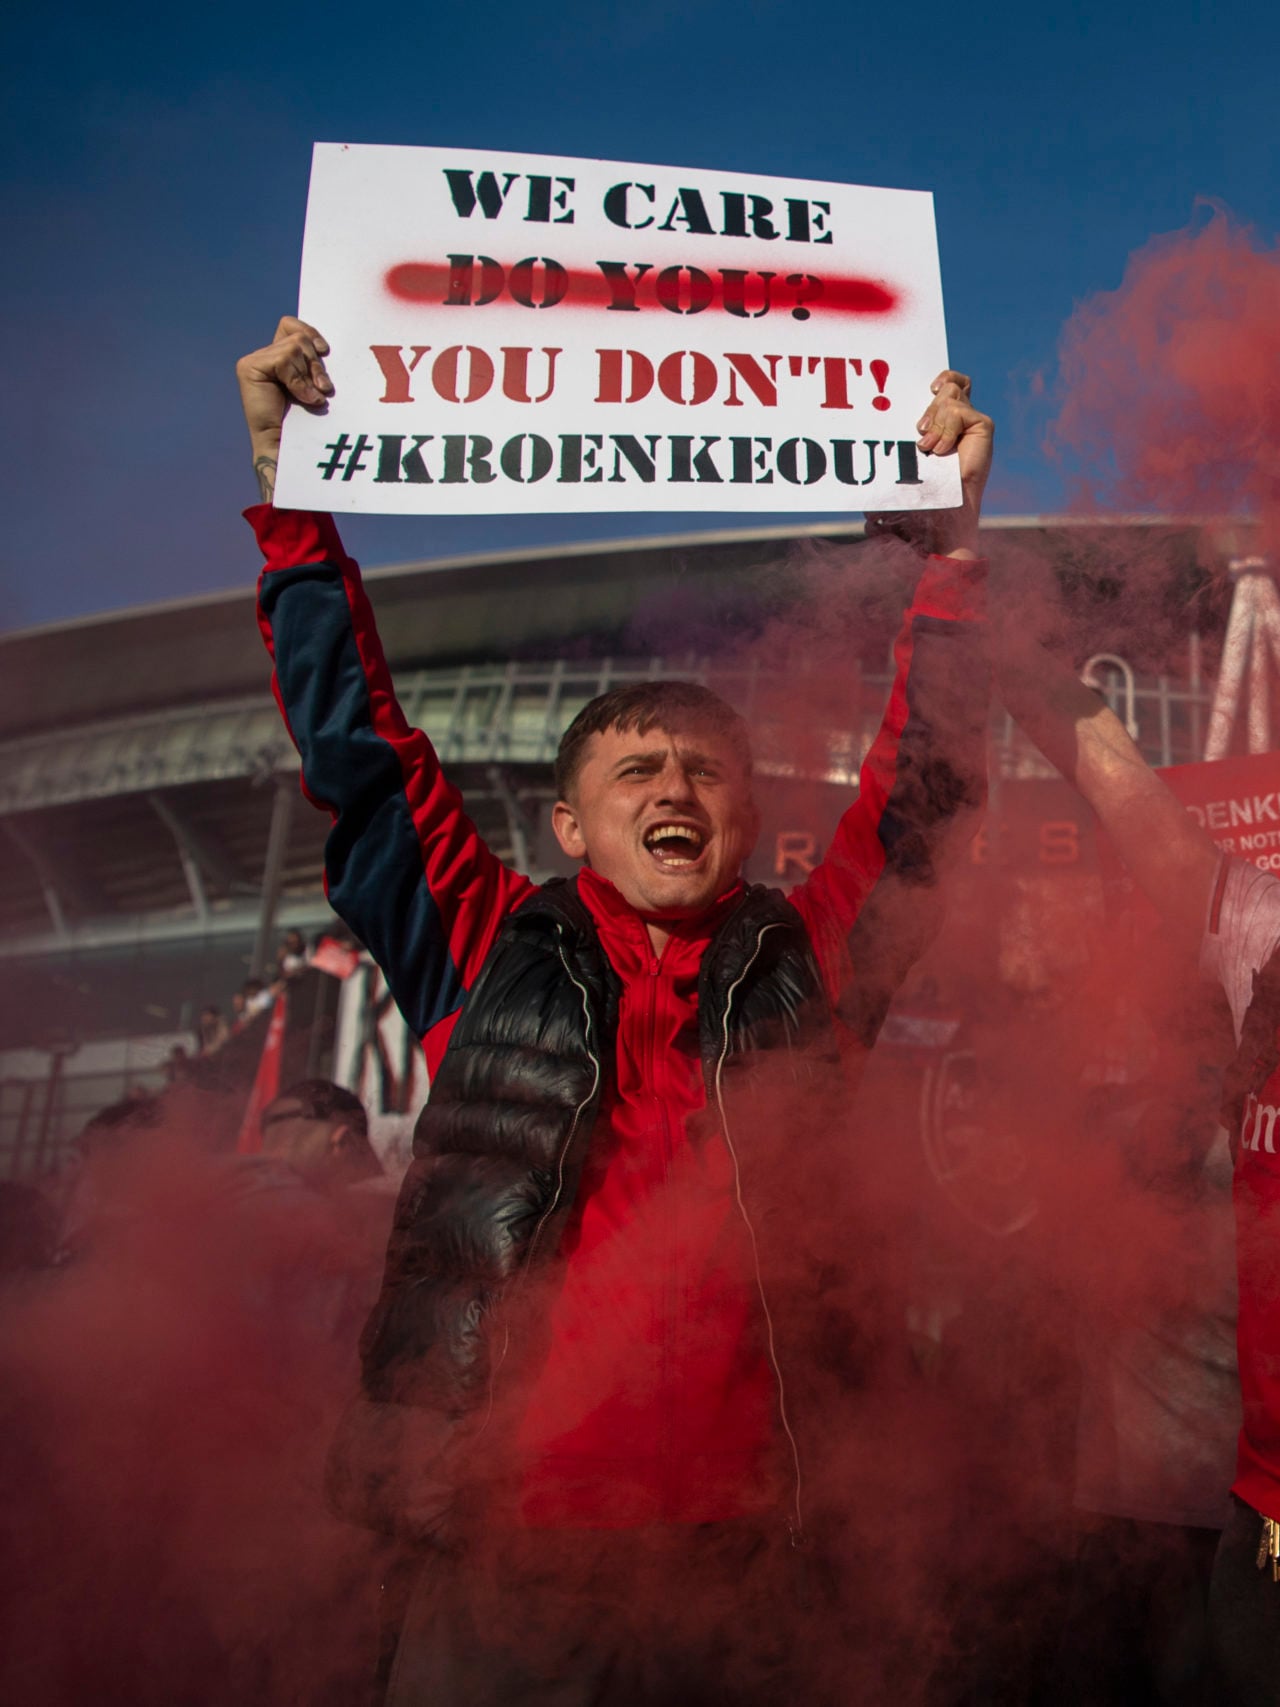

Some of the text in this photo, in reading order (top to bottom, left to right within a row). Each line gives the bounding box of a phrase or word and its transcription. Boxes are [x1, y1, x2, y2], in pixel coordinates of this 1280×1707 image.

[442, 168, 834, 246] WE CARE
[440, 252, 826, 323] DO YOU?
[369, 345, 892, 413] YOU DON'T!
[316, 432, 924, 487] #KROENKEOUT
